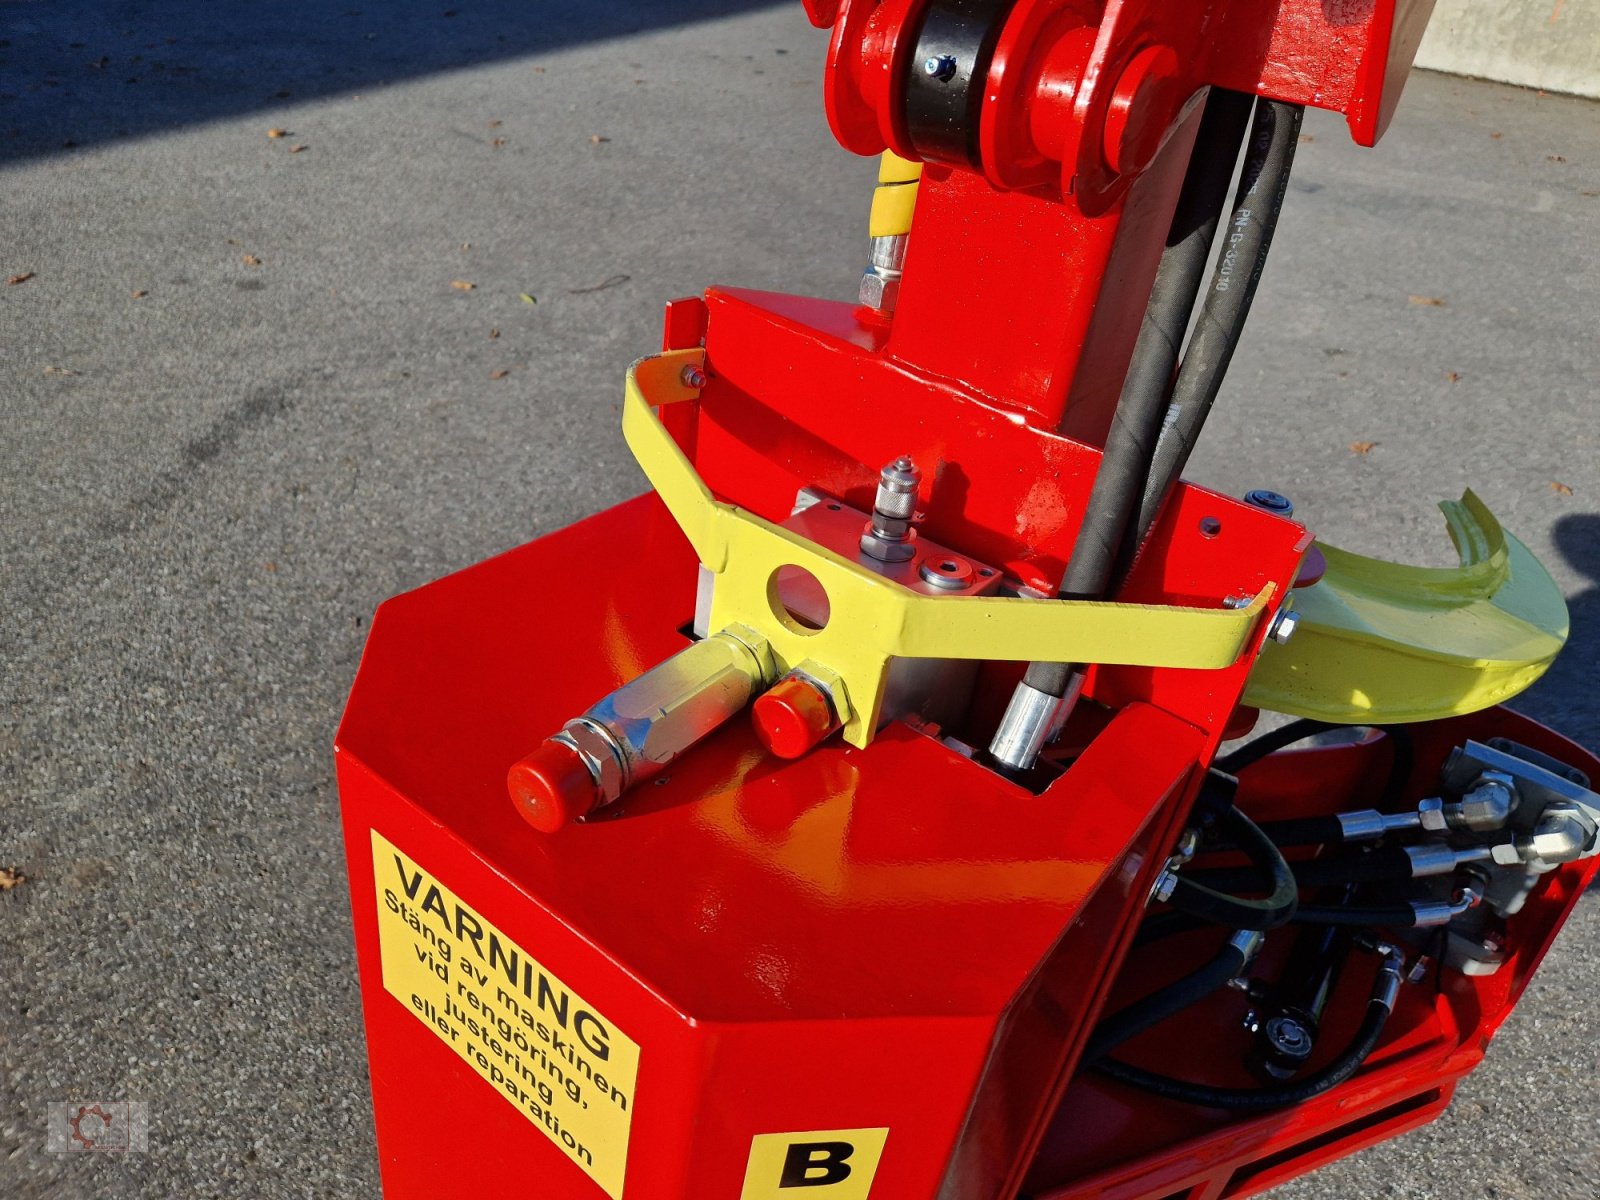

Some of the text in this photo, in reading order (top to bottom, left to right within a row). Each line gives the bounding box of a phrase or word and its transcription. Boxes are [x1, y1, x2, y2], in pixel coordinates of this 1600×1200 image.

[384, 888, 627, 1112] Stäng av maskinen
[393, 853, 610, 1061] VARNING
[414, 942, 588, 1110] vid rengöring,
[411, 993, 592, 1167] eller reparation
[443, 993, 553, 1107] justering
[778, 1141, 855, 1188] B
